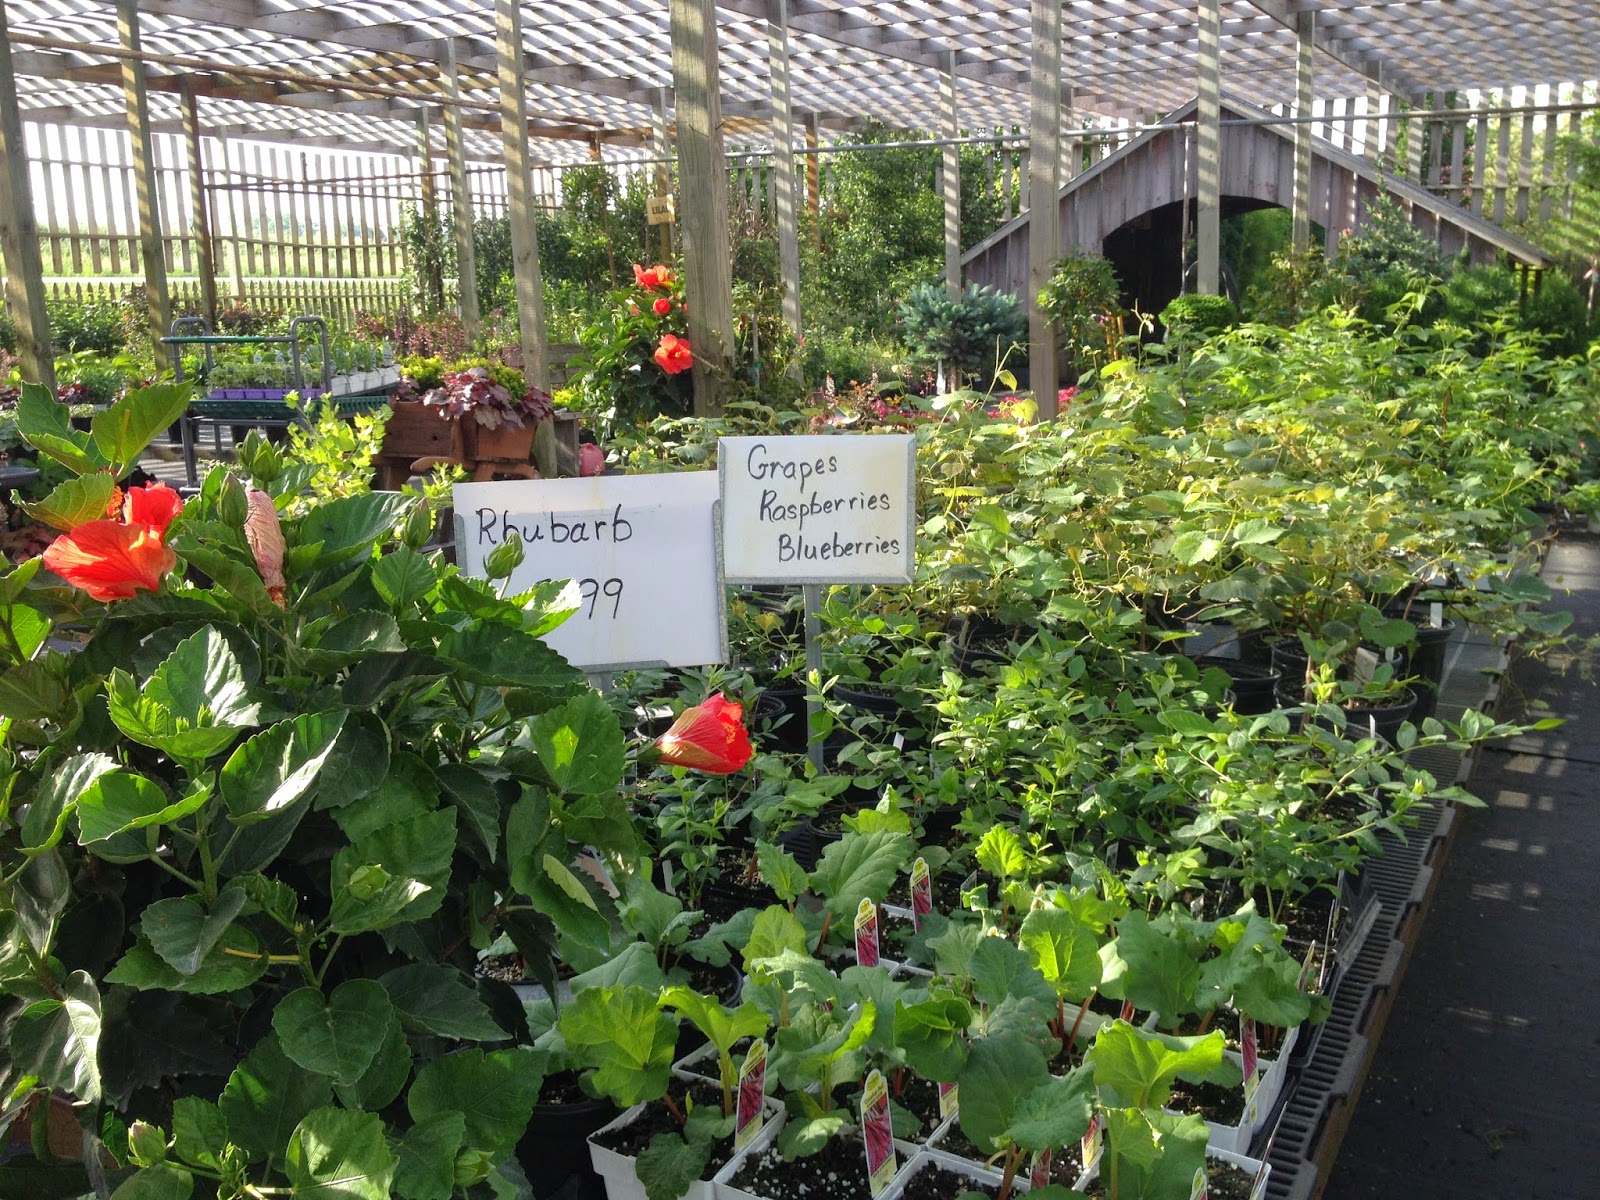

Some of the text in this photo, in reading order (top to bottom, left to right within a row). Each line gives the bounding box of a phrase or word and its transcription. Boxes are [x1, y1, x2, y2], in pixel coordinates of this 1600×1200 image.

[747, 444, 838, 493] Grapes
[475, 503, 633, 543] Rhubarb
[760, 490, 891, 531] Raspberries
[778, 532, 900, 562] Blueberries
[537, 578, 623, 619] 99
